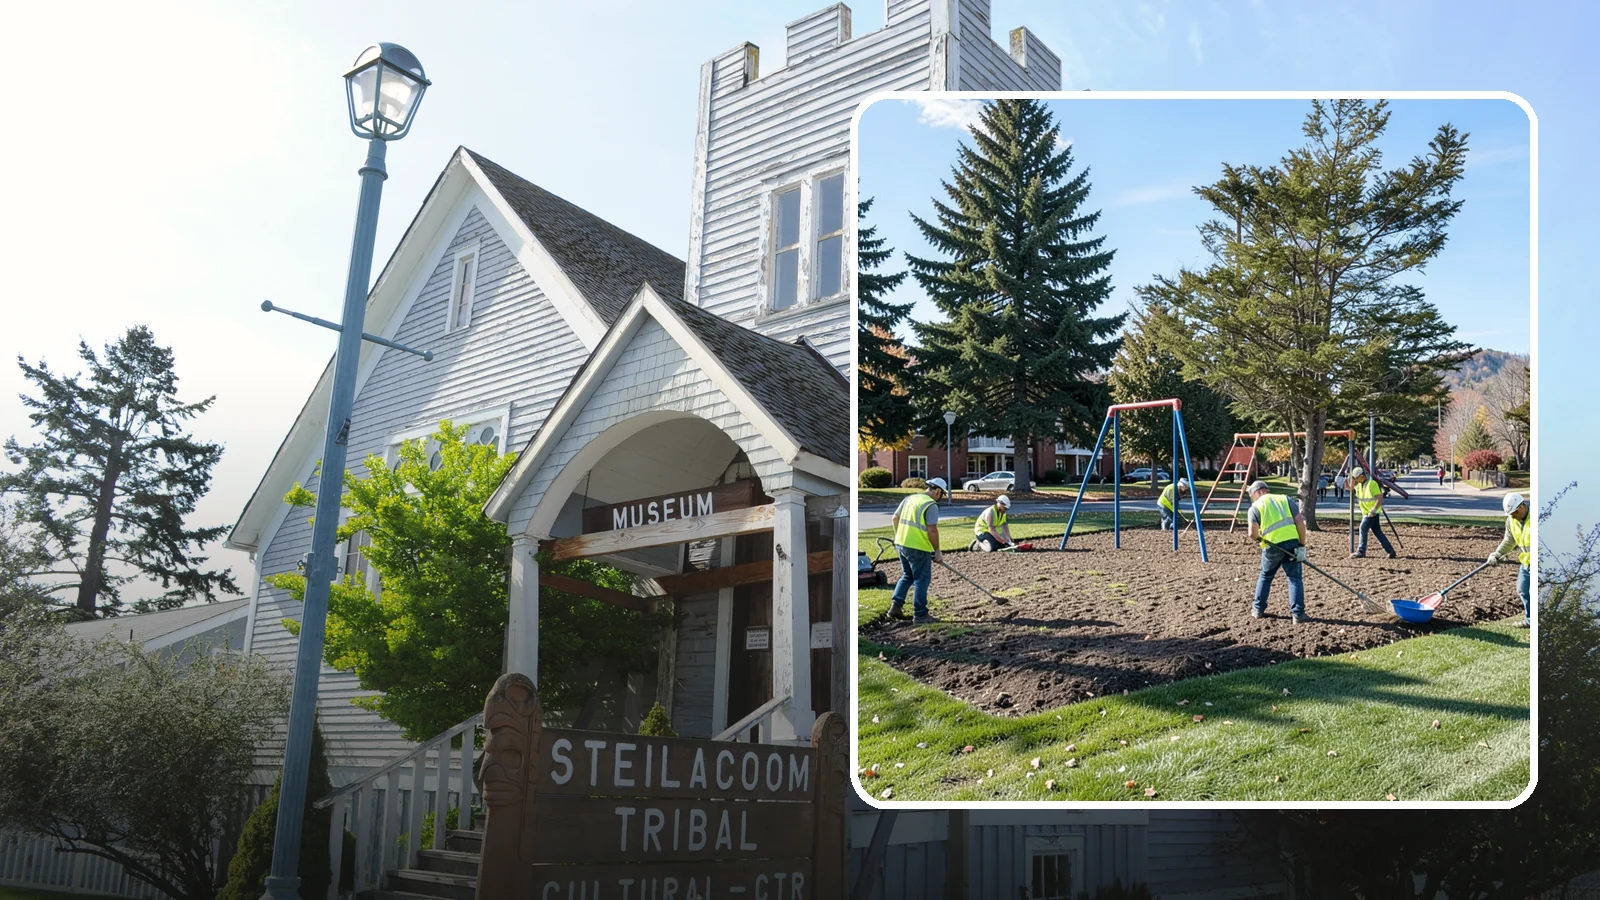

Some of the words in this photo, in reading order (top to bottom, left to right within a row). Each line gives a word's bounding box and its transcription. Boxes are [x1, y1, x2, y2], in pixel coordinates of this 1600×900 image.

[613, 491, 713, 530] MUSEUM
[551, 738, 810, 792] STEILACOOM
[615, 806, 757, 851] TRIBAL
